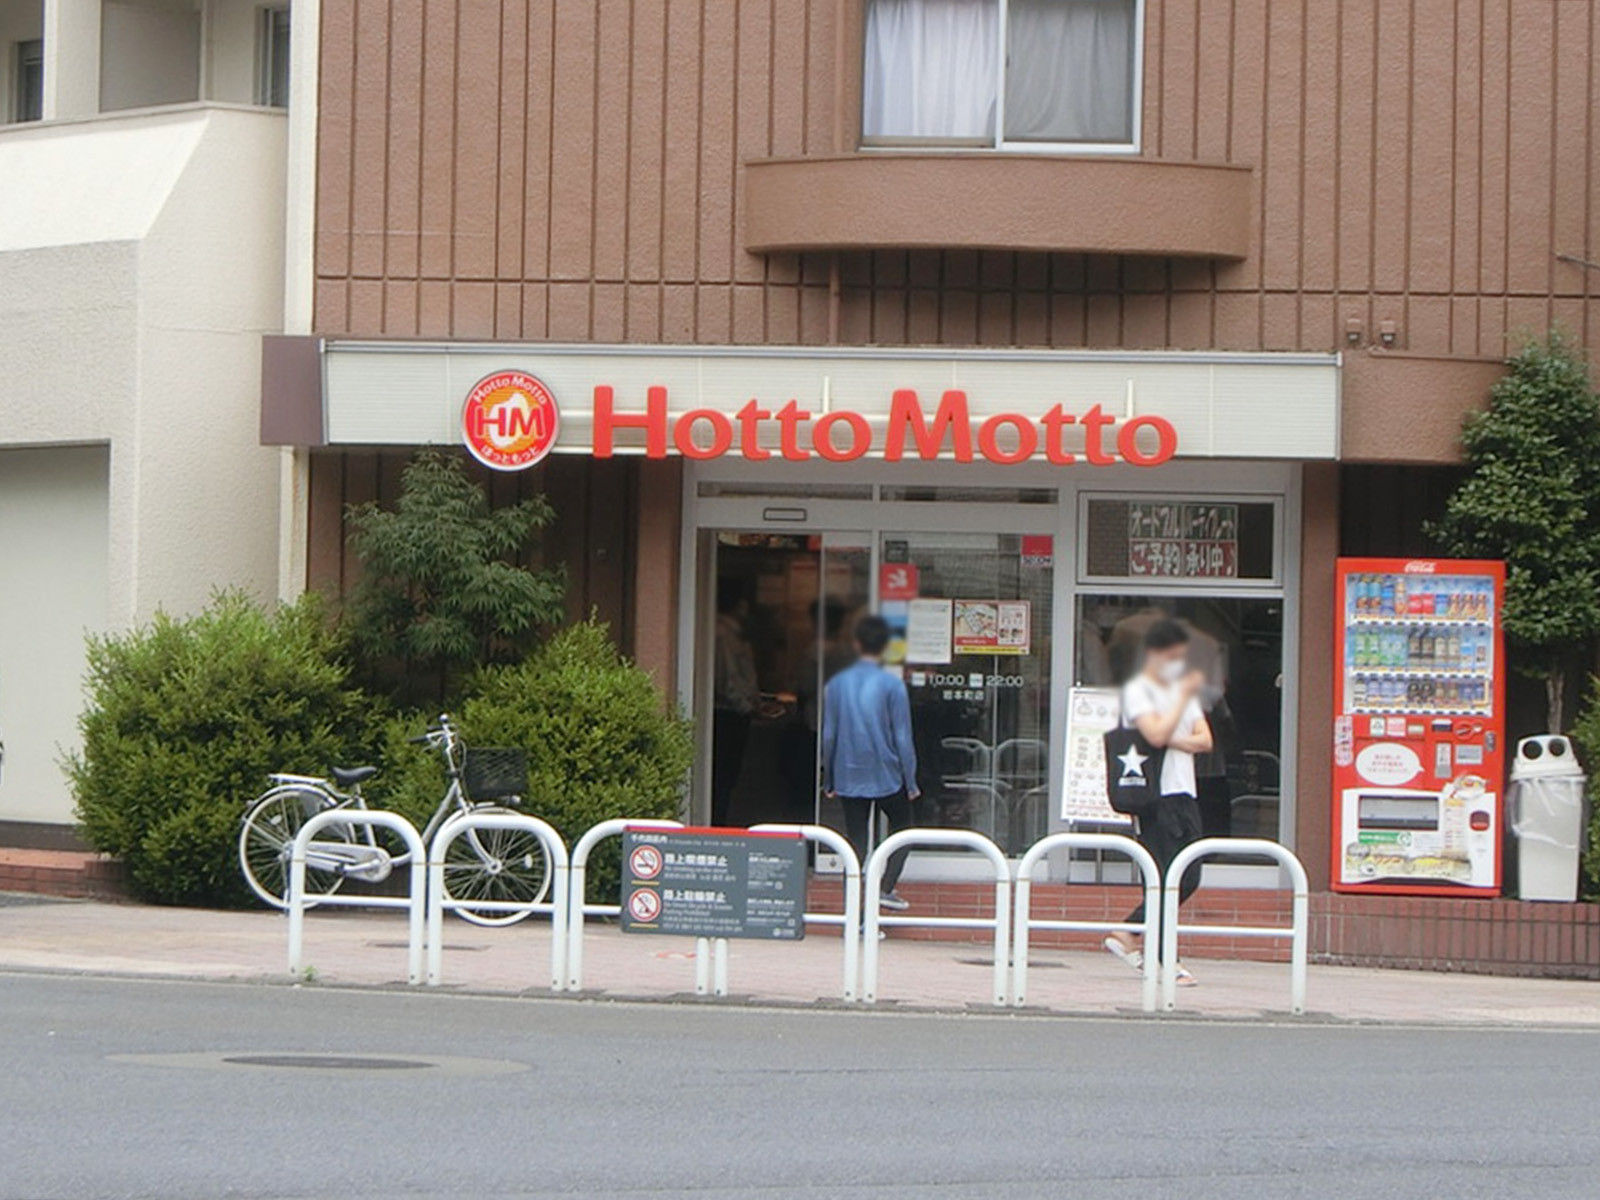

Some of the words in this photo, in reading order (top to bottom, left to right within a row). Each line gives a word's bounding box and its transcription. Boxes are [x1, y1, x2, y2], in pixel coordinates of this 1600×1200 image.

[473, 377, 511, 403] Hotto
[511, 375, 548, 405] Motto
[474, 405, 546, 439] HM
[592, 385, 873, 462] Hotto
[884, 389, 1178, 467] Motto
[480, 445, 541, 465] ほっともっと
[986, 675, 1024, 688] 22:00
